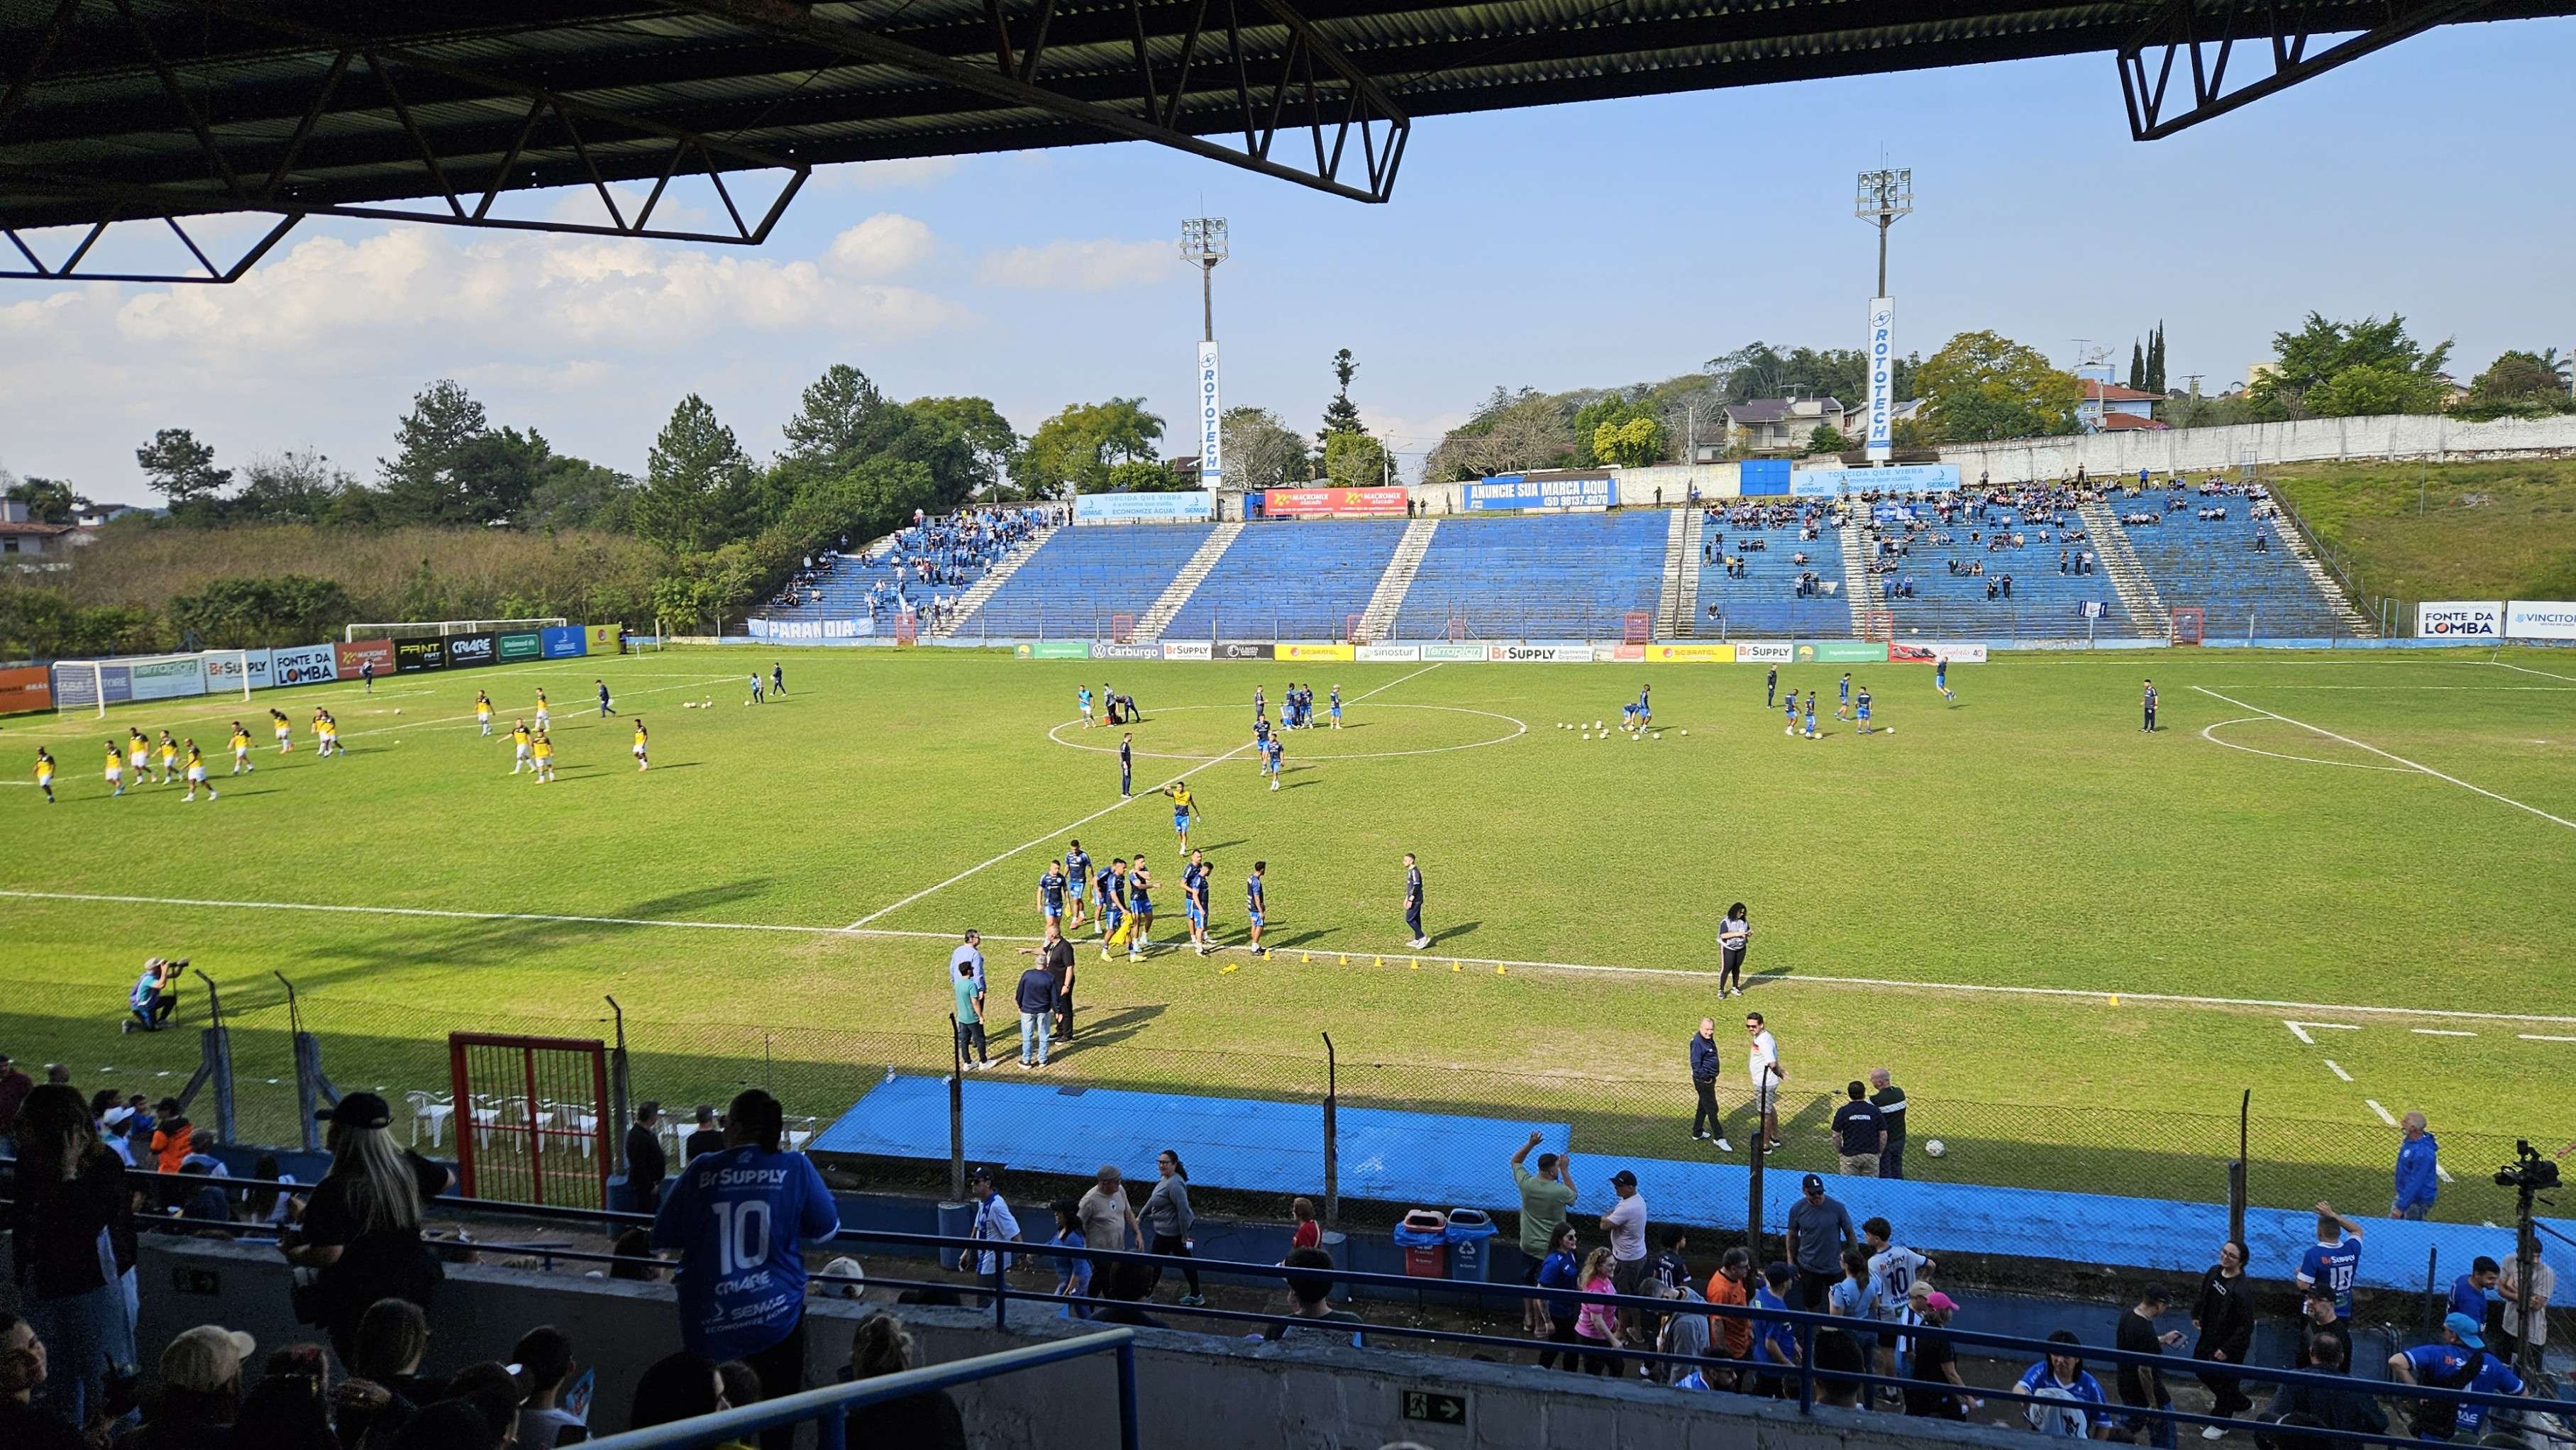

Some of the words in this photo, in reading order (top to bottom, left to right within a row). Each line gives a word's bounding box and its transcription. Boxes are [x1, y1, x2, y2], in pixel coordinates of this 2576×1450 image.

[1872, 329, 1888, 438] ROTOTECH
[1204, 370, 1217, 467] ROTOTECH
[1471, 483, 1515, 499] ANUNCIE
[1518, 483, 1538, 497] SUA
[1542, 481, 1580, 496] MARCA
[1583, 480, 1608, 494] AQUI
[1544, 497, 1559, 507] (51)
[1561, 495, 1608, 506] 98137-6070
[2426, 612, 2468, 621] FONTE
[2475, 612, 2494, 621] DA
[2526, 614, 2576, 623] VINCITO
[2425, 622, 2493, 634] LOMBA
[452, 638, 491, 653] CRIARE
[1108, 646, 1158, 659] Carburgo
[1374, 648, 1414, 656] sinostur
[1425, 646, 1481, 658] Terraplan
[277, 654, 310, 668] FONTE
[316, 653, 331, 663] DA
[279, 665, 333, 684] LOMBA
[711, 1200, 770, 1275] 10
[1659, 1267, 1674, 1289] 10
[1886, 1266, 1909, 1297] 10
